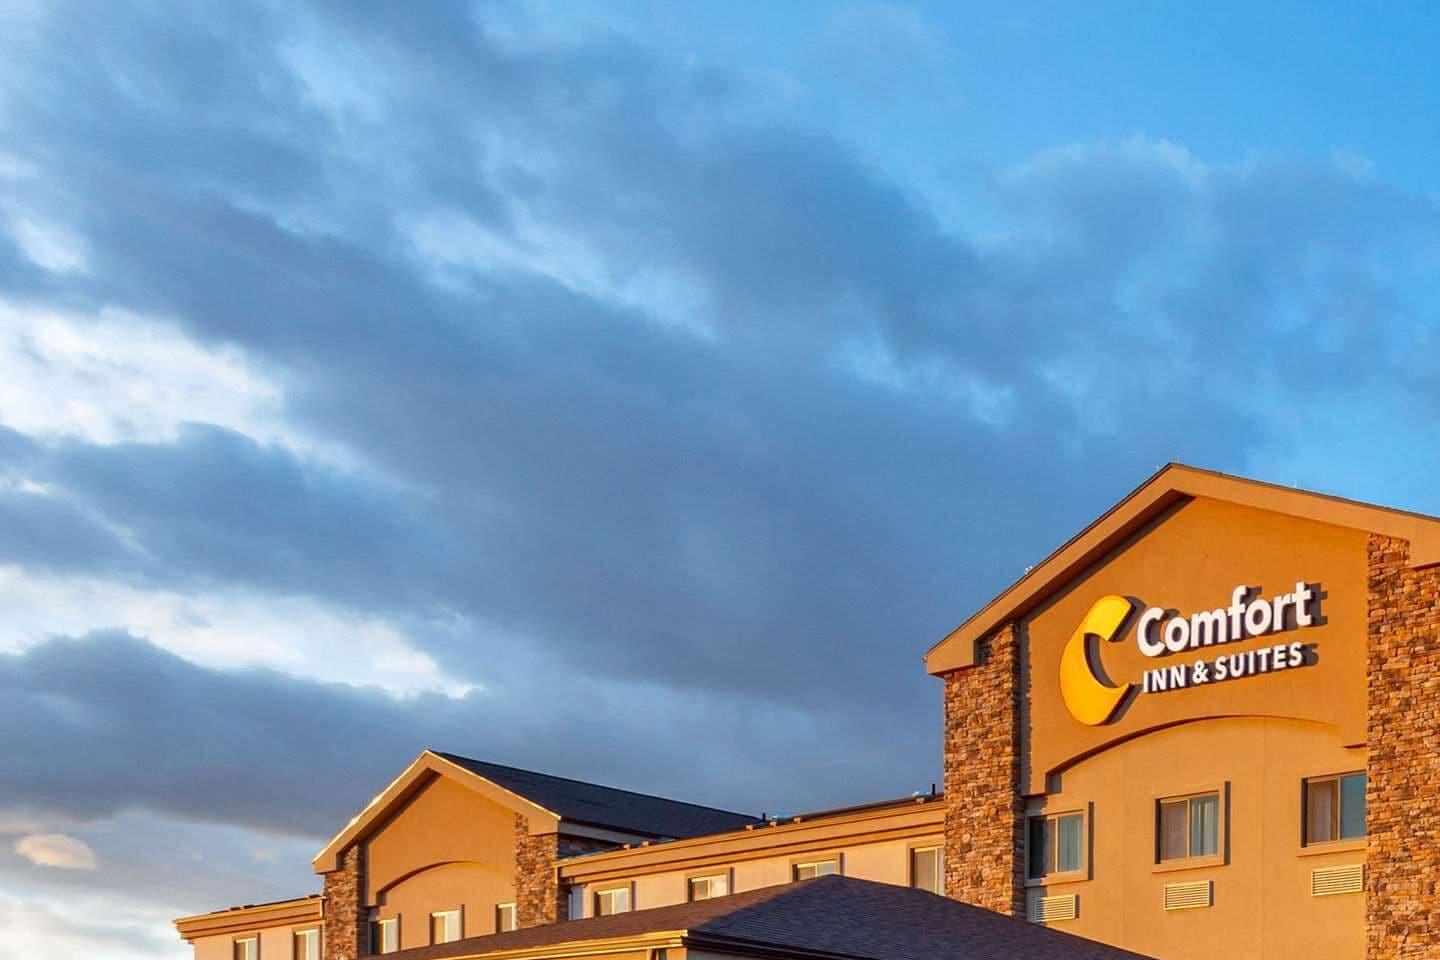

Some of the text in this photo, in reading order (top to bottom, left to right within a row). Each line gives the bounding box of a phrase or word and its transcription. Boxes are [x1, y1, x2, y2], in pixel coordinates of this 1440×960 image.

[1137, 581, 1312, 657] Comfort
[1143, 641, 1303, 693] INN & SUITES
